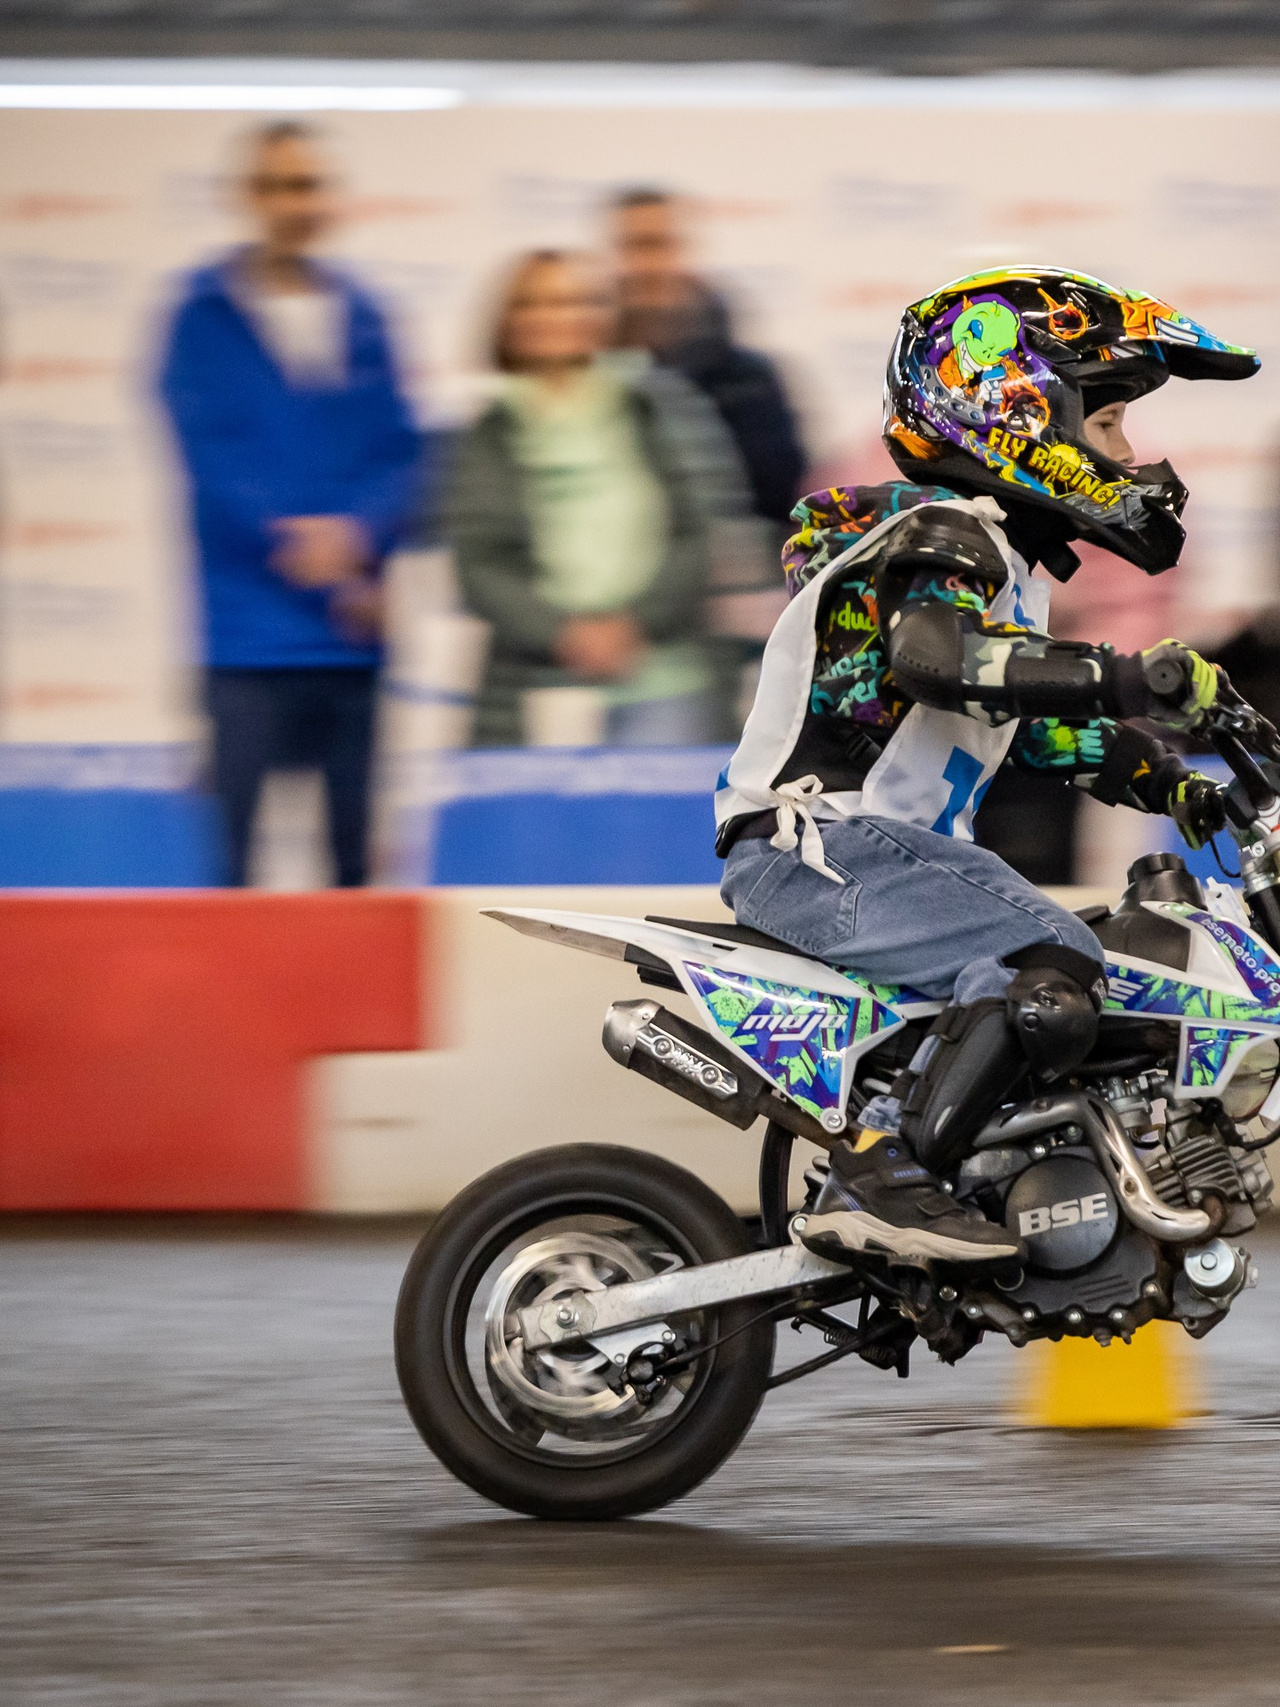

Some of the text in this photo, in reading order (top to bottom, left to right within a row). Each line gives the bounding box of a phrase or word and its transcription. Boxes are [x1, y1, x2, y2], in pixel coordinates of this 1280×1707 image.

[988, 427, 1120, 511] FLY RACING!
[742, 1014, 848, 1041] mojo
[1018, 1192, 1109, 1237] BSE
